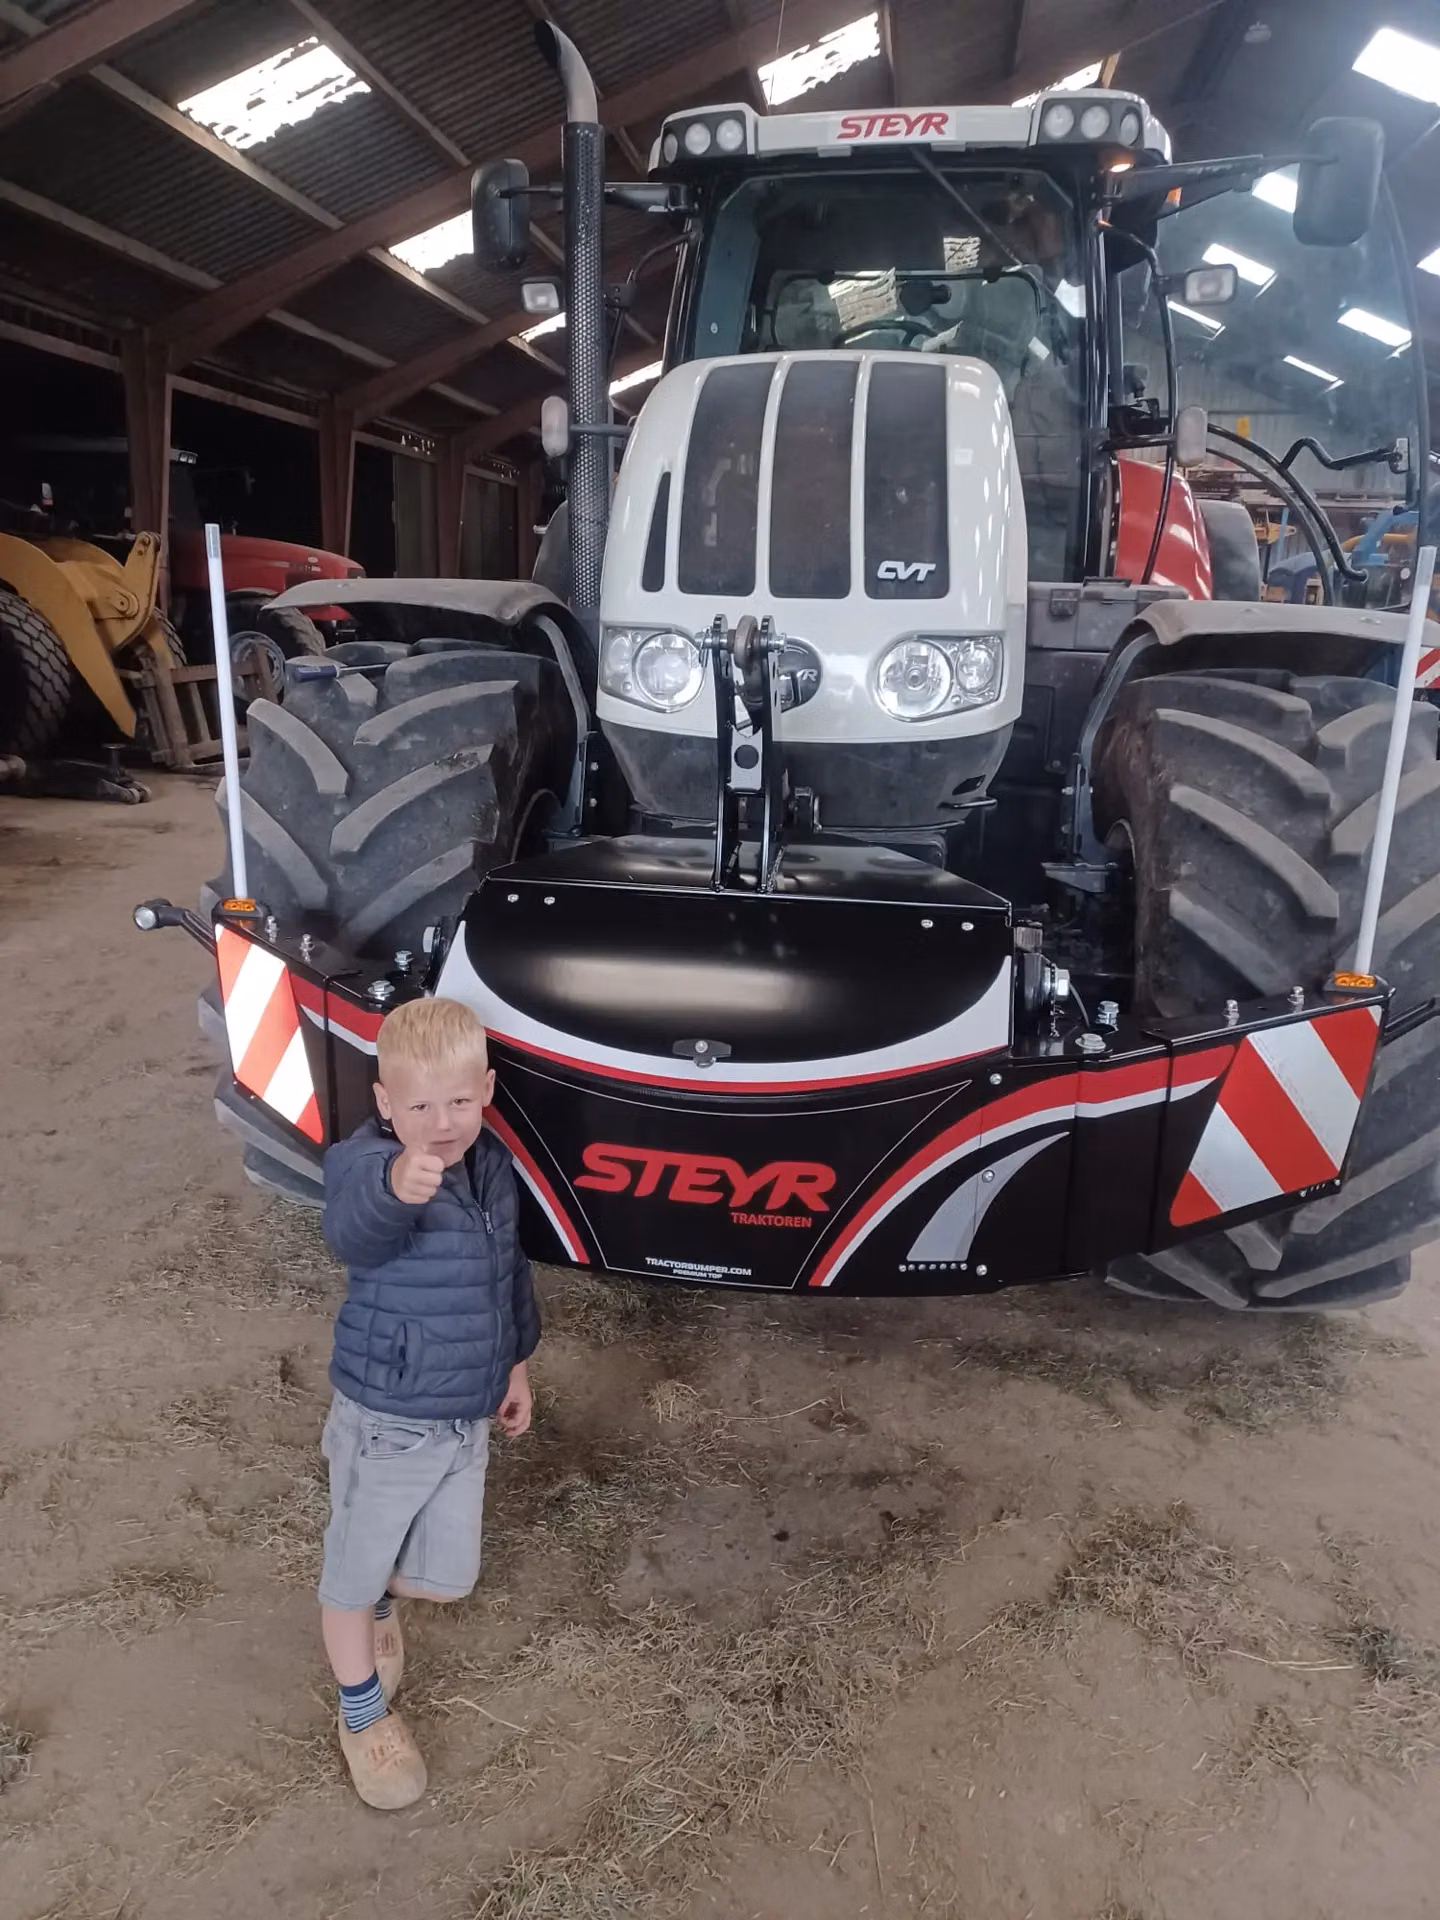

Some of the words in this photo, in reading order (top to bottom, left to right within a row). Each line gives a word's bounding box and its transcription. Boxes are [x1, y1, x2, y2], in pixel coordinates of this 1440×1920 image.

[836, 112, 949, 139] STEYR
[877, 560, 936, 582] CVT
[573, 1142, 836, 1212] STEYR
[731, 1212, 812, 1228] TRAKTOREN
[645, 1257, 752, 1276] TRACTORBUMPER.COM
